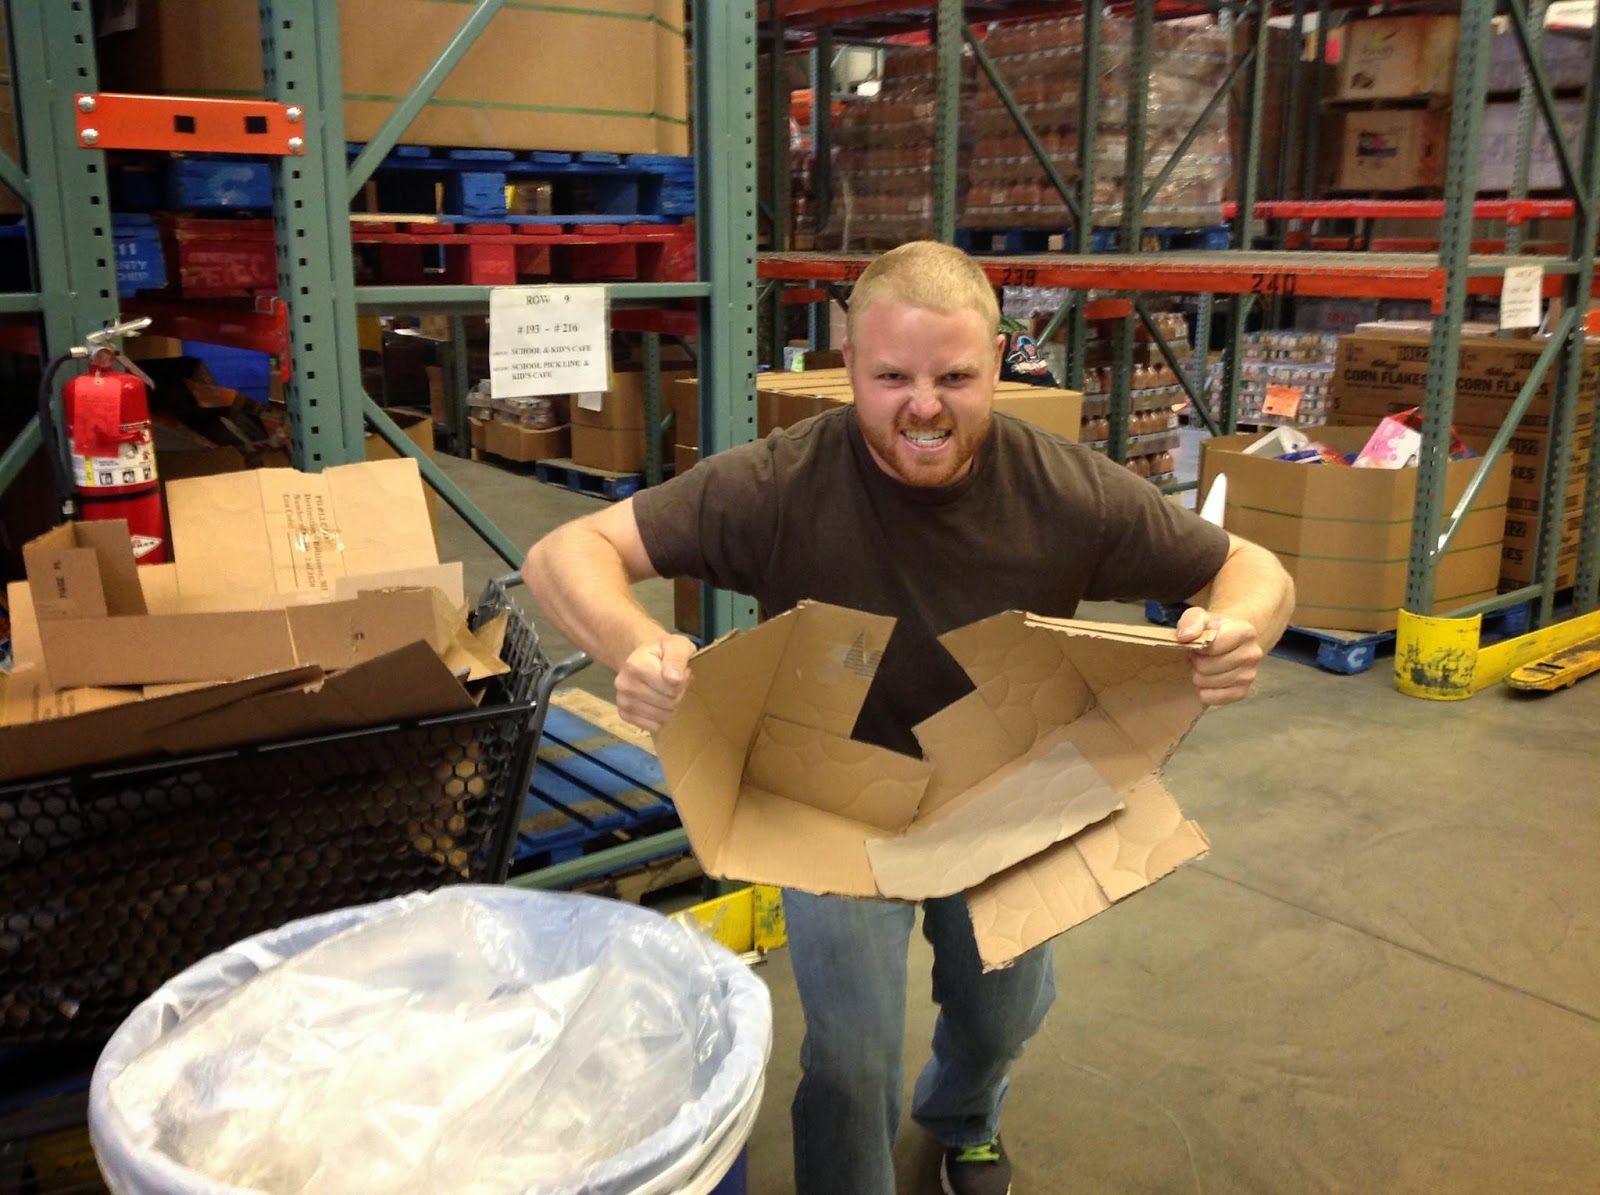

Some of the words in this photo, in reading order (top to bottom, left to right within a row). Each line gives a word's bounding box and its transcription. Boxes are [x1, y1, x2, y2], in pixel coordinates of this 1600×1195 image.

[1250, 272, 1297, 295] 240
[526, 294, 550, 305] ROW
[563, 294, 570, 305] 9
[511, 347, 541, 355] SCHOOL
[542, 346, 549, 354] &
[571, 344, 592, 352] CAFE
[511, 362, 542, 370] SCHOOL
[543, 361, 561, 369] PICK
[562, 360, 581, 368] LINE
[583, 359, 590, 367] &
[532, 370, 552, 379] CAFE
[1344, 369, 1377, 382] CORN
[1381, 371, 1428, 386] FLAKES
[1456, 377, 1493, 391] CORN
[1496, 380, 1549, 396] FLAS
[1347, 646, 1367, 668] C
